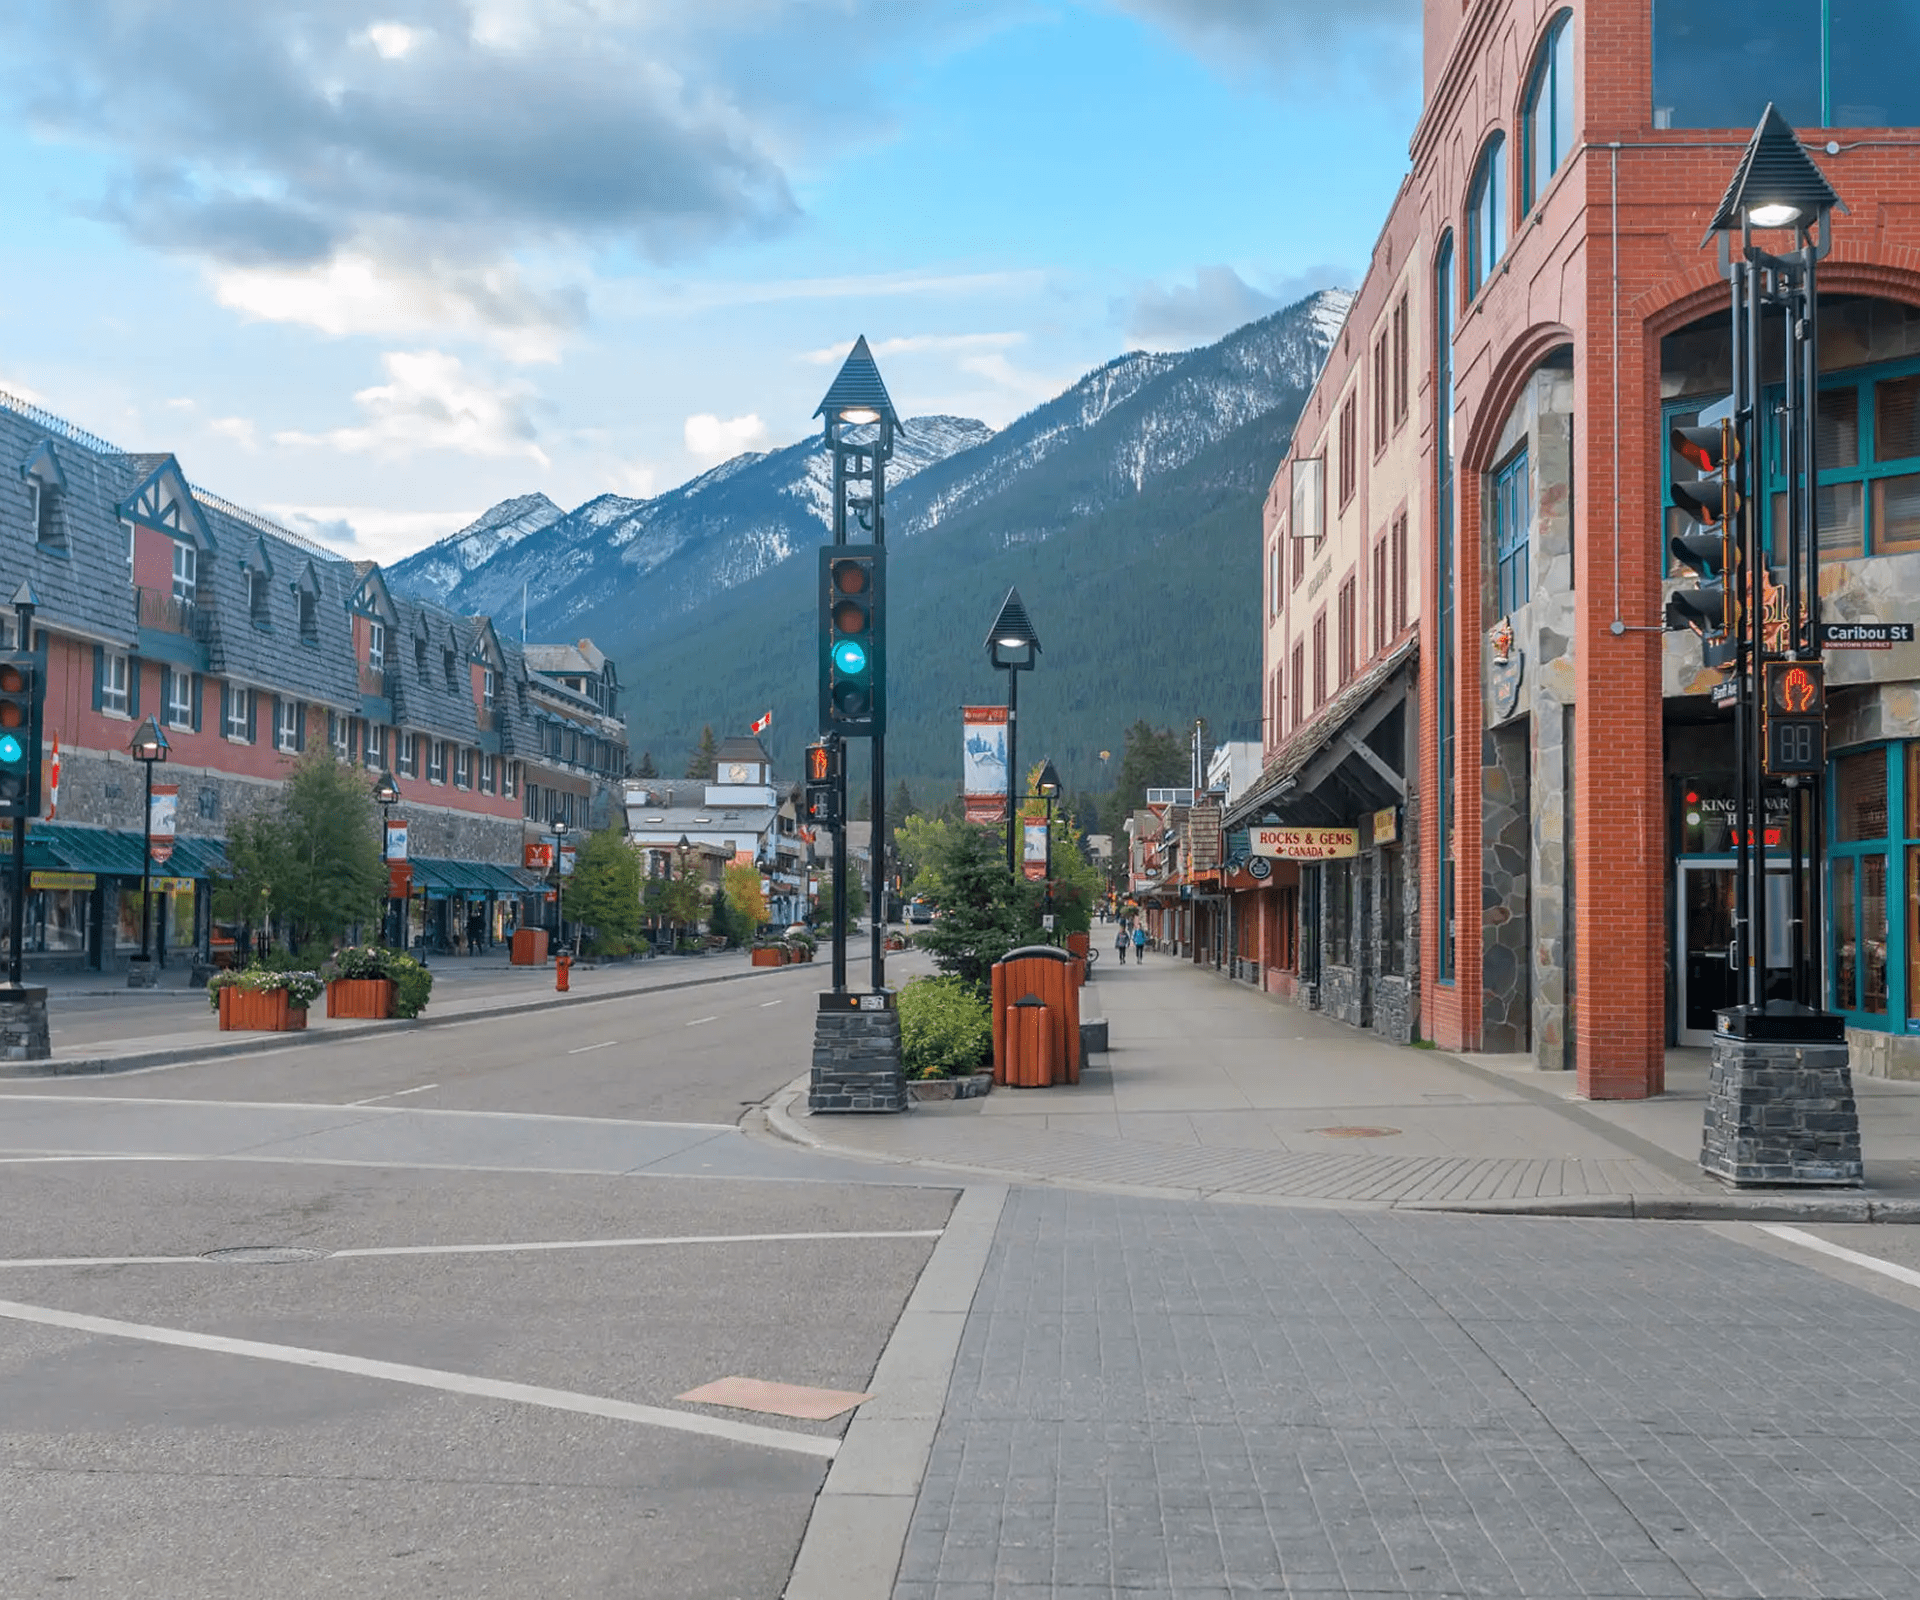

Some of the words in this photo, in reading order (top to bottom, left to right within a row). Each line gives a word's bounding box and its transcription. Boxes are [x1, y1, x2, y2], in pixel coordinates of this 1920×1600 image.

[1827, 626, 1886, 640] Caribou
[1890, 626, 1908, 640] St
[1701, 799, 1736, 811] KING
[1259, 832, 1300, 845] ROCKS
[1305, 833, 1314, 845] &
[1319, 833, 1353, 845] GEMS
[1287, 846, 1324, 857] CANADA
